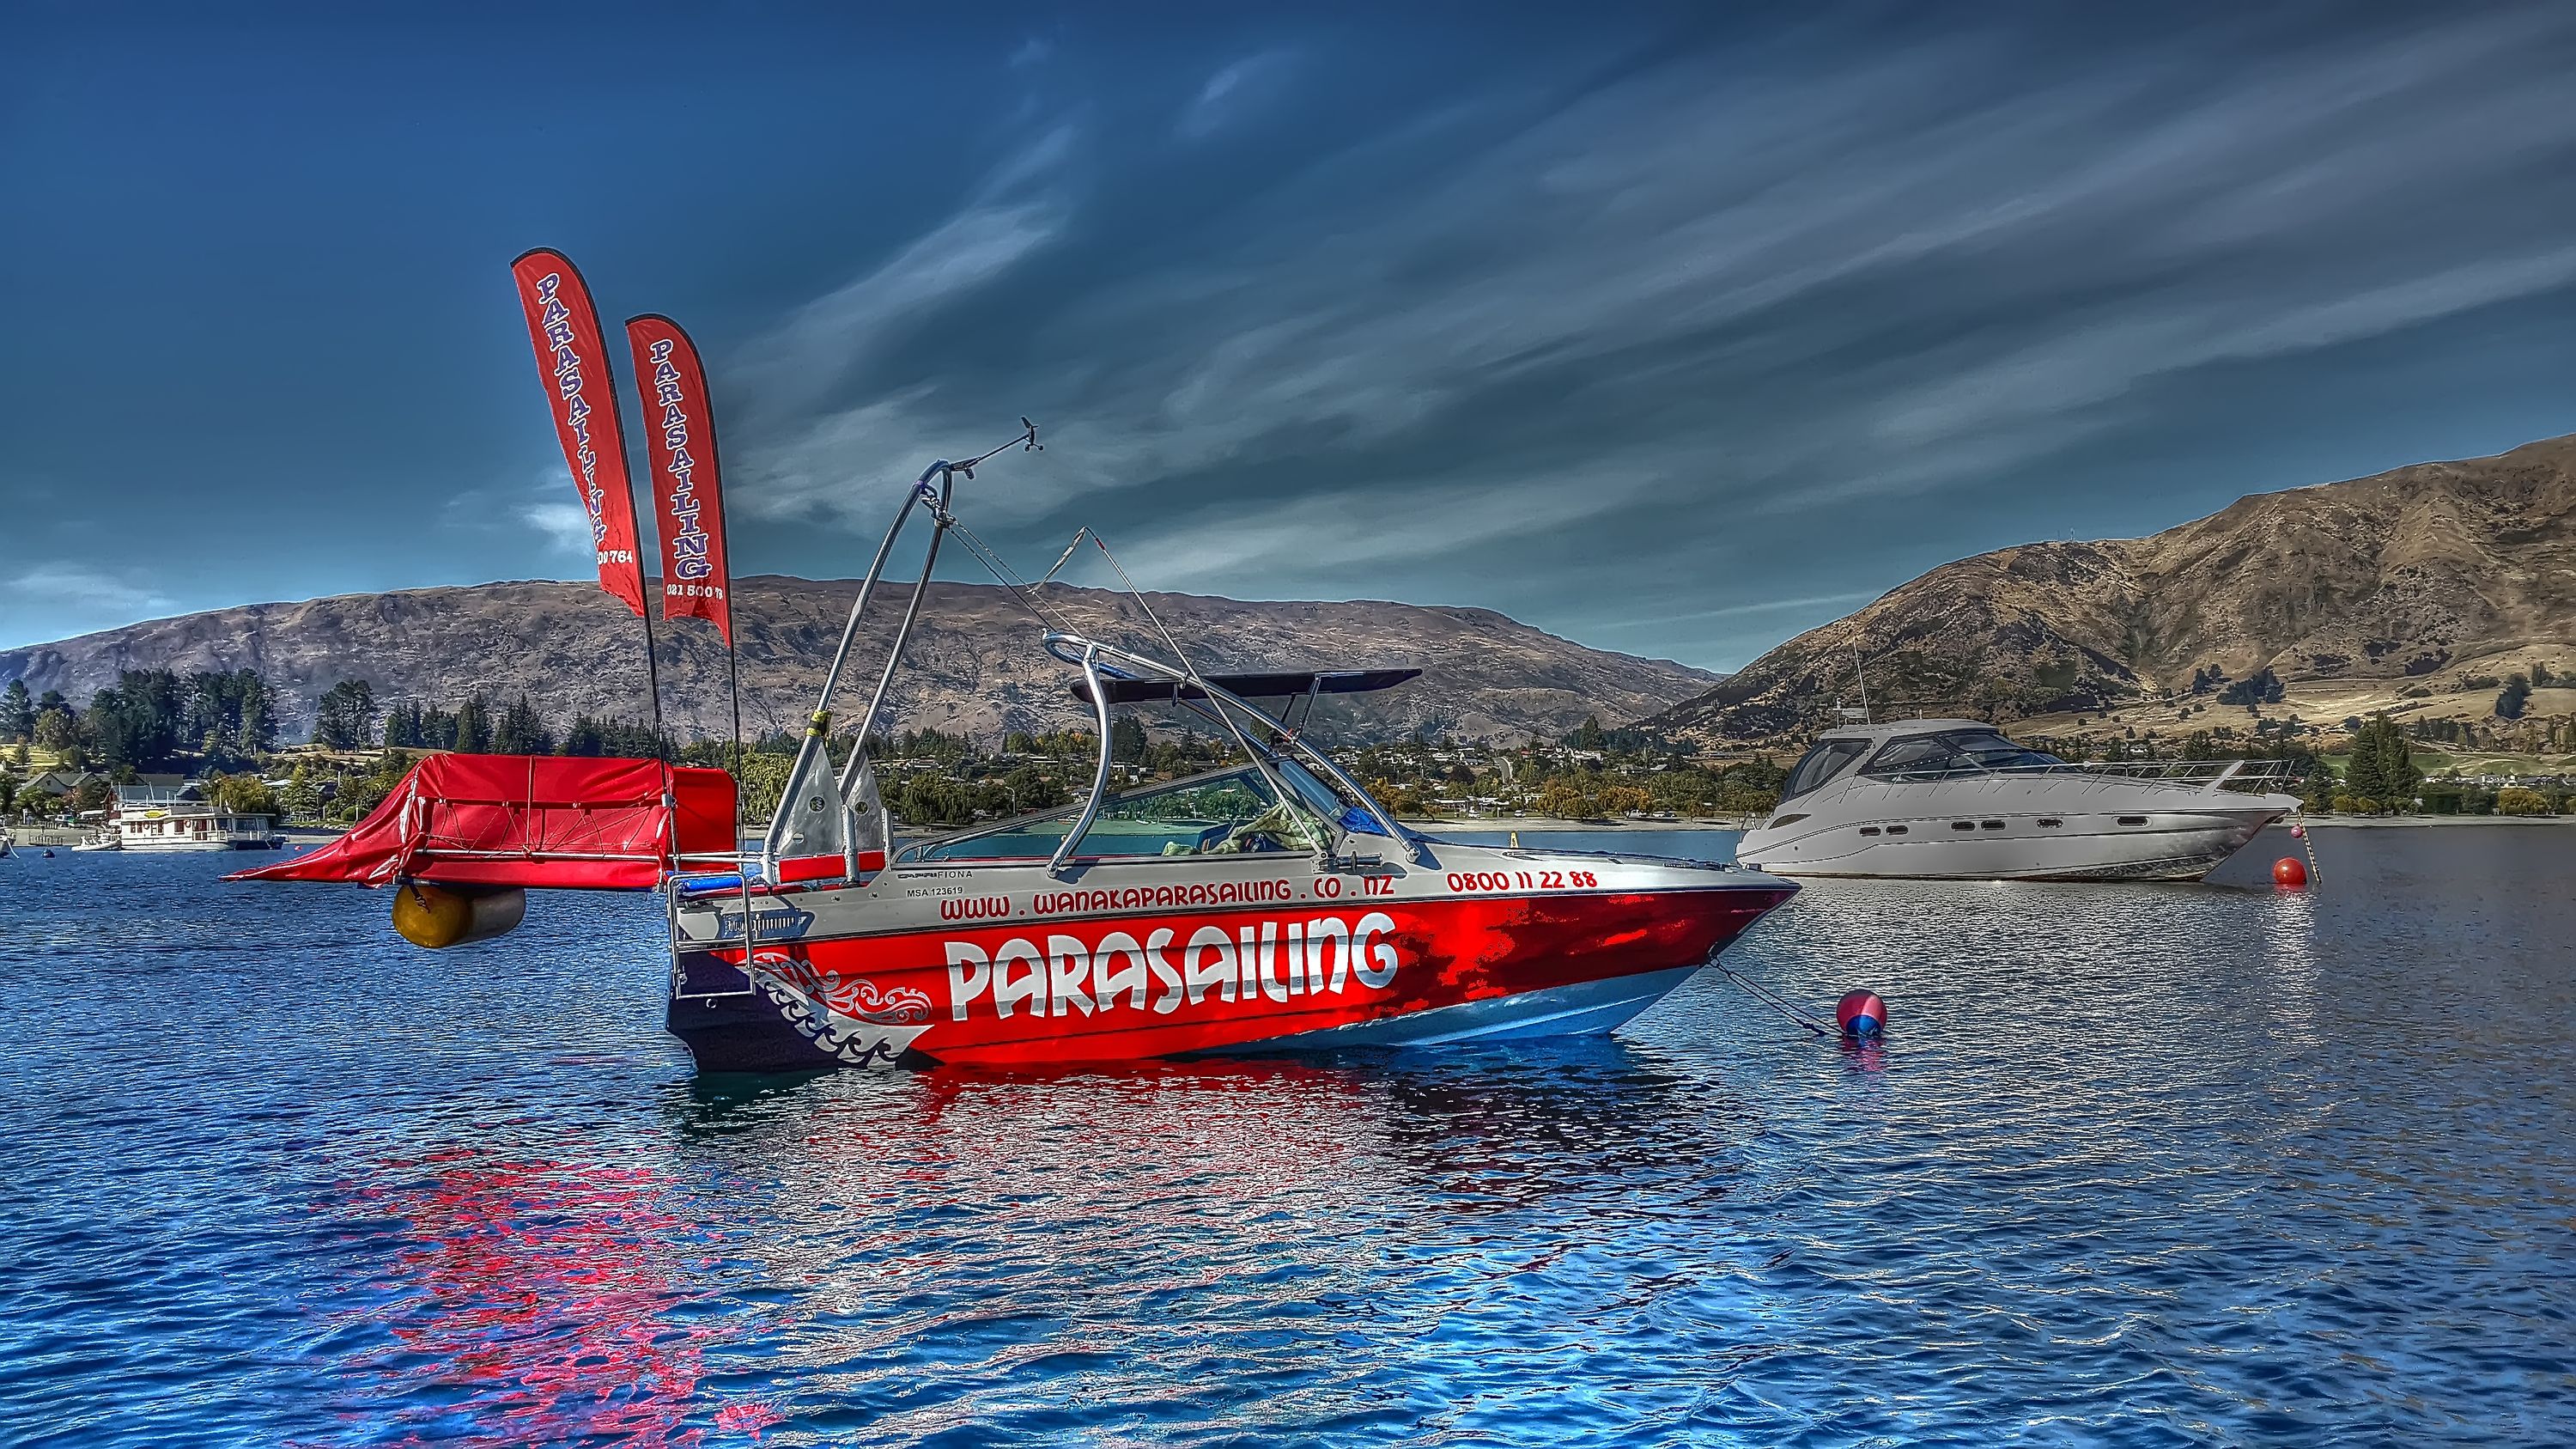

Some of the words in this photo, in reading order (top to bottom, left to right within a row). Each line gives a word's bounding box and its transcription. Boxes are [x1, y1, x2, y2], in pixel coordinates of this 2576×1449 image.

[537, 272, 607, 544] PARASAILING
[650, 338, 712, 580] PARASAILING
[907, 889, 928, 898] MSA
[932, 886, 963, 896] 123619
[1314, 877, 1341, 898] CO
[1447, 872, 1510, 892] 0800
[1515, 871, 1533, 889] 11
[1538, 871, 1565, 888] 22
[1569, 871, 1598, 888] 88
[945, 911, 1398, 1022] PARASAILING
